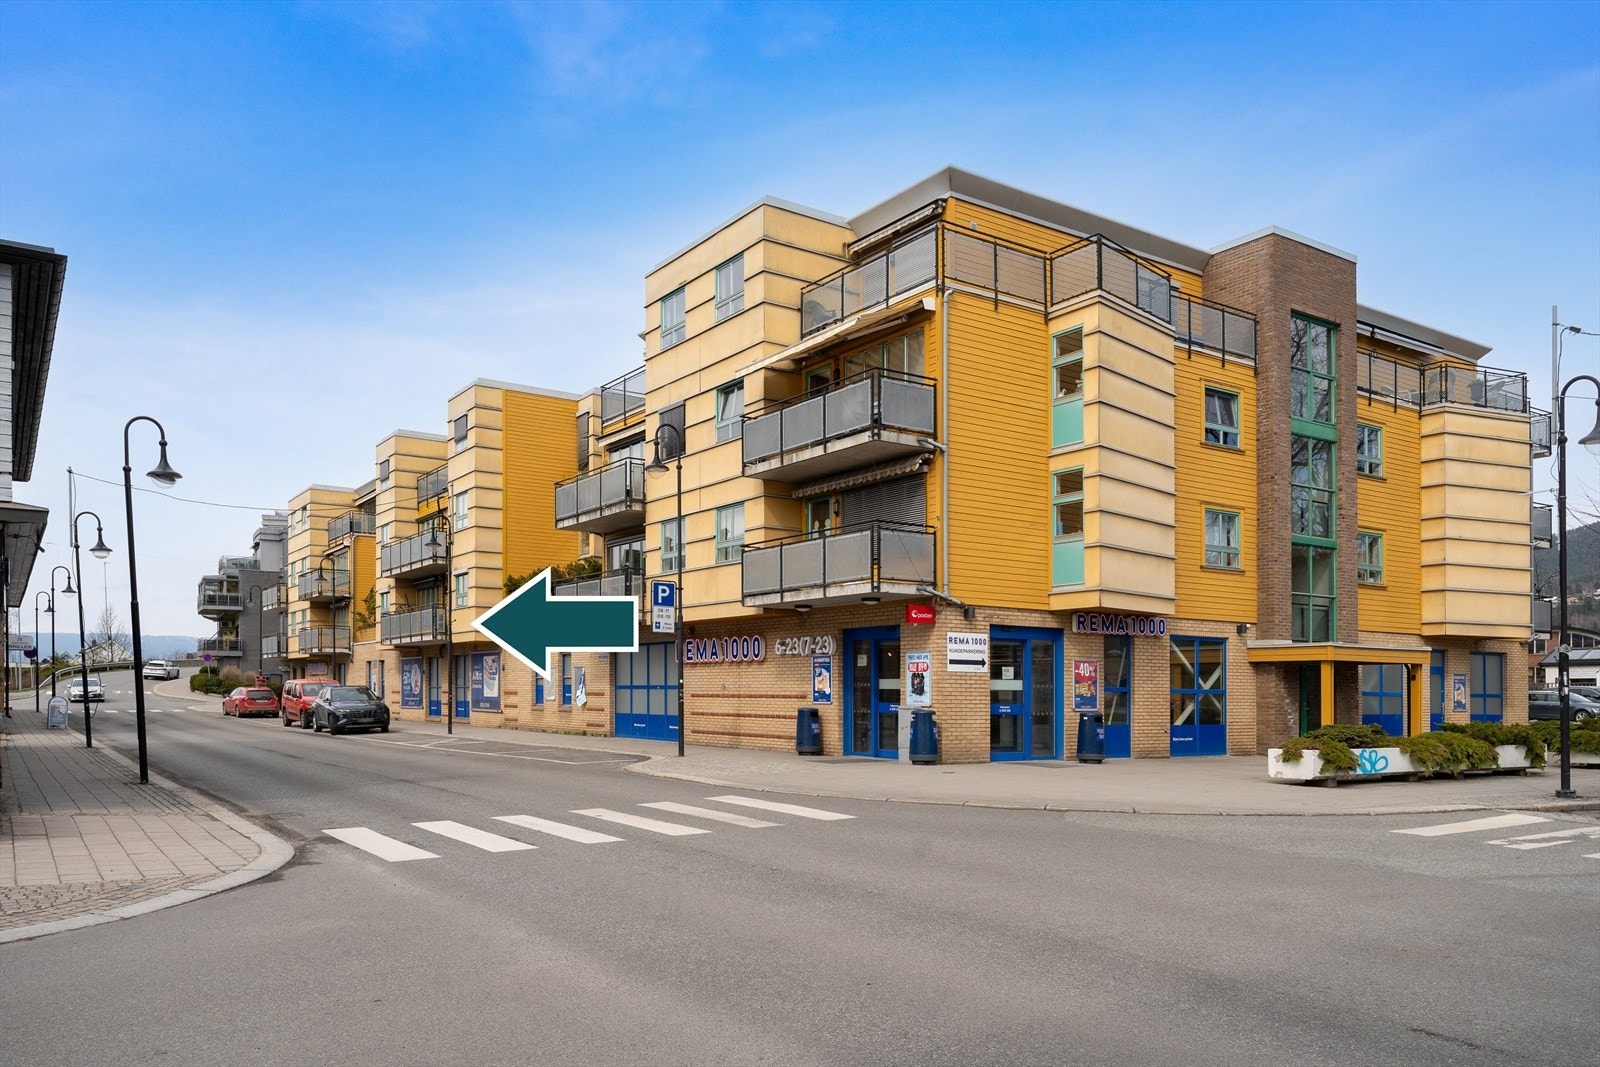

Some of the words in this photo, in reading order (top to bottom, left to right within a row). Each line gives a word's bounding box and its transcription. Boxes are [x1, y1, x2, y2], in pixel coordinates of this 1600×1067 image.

[658, 585, 670, 604] P
[1076, 613, 1127, 635] REMA
[1131, 616, 1167, 637] 1000
[723, 635, 762, 661] 1000
[948, 636, 970, 646] REMA
[971, 637, 987, 646] 1000
[1075, 663, 1096, 677] -40%
